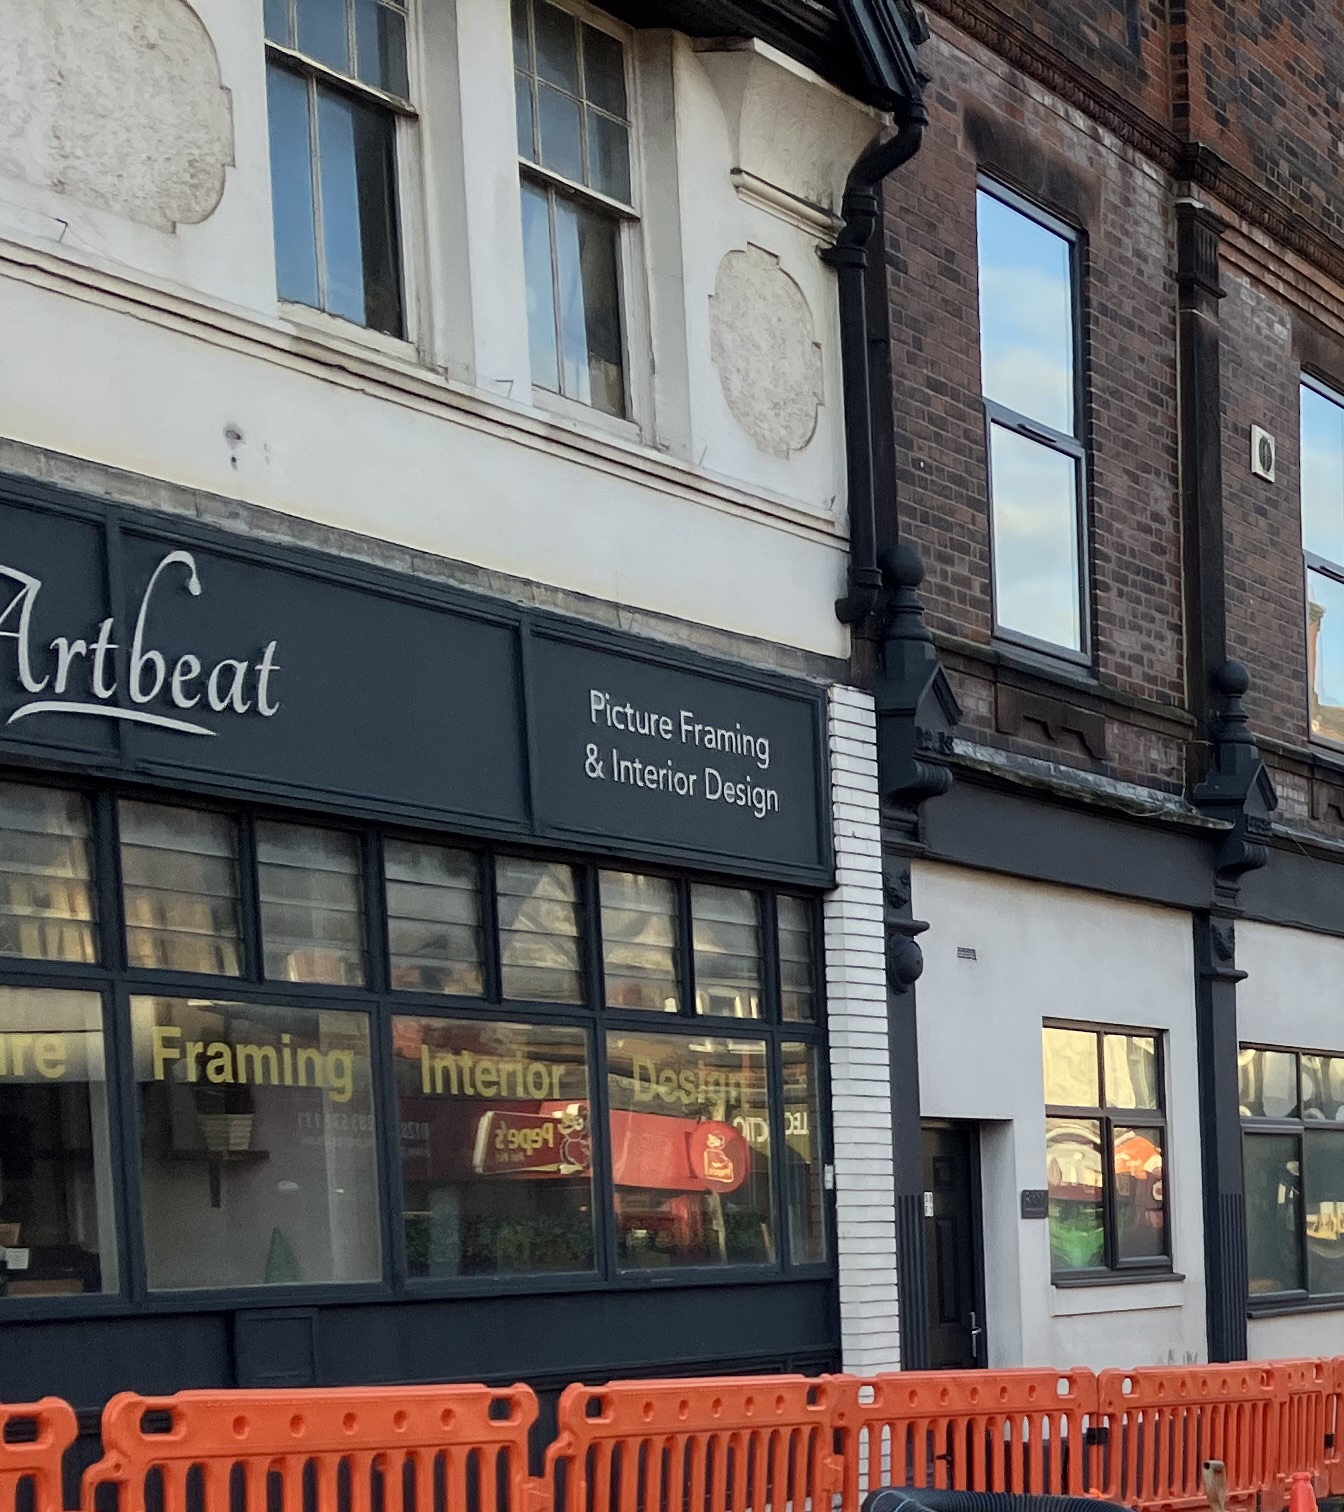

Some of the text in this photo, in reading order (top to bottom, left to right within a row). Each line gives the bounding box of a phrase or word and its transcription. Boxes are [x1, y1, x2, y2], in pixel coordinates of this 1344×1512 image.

[0, 550, 281, 717] Artbeat
[588, 689, 772, 768] Picture Framing
[584, 744, 780, 820] & Interior Design
[152, 1026, 354, 1103] Framing
[421, 1044, 566, 1099] Interior
[632, 1055, 747, 1105] Design
